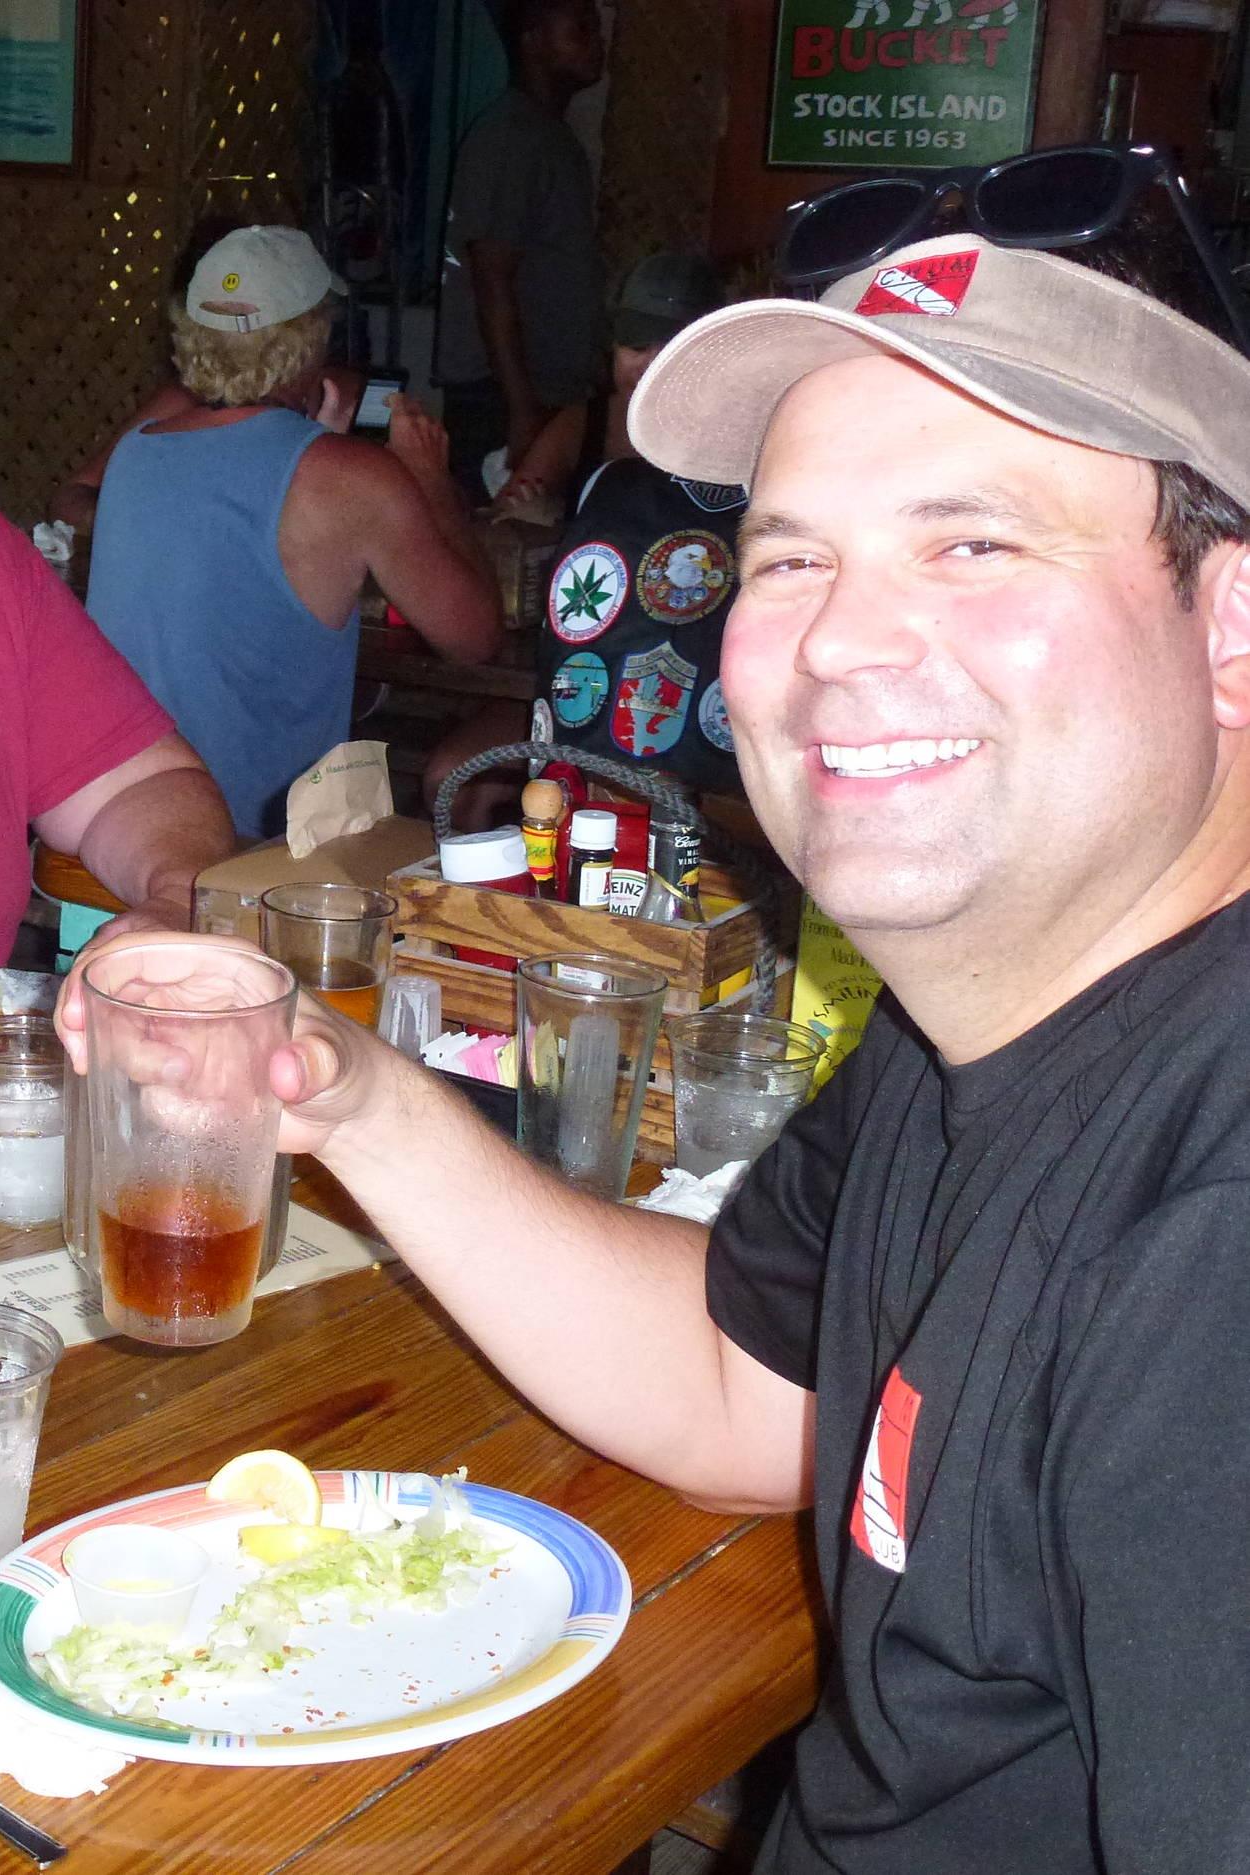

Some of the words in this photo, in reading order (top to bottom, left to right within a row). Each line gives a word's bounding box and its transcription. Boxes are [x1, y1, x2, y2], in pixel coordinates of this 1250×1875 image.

[791, 26, 1008, 80] BUCKET
[794, 94, 882, 118] STOCK
[890, 94, 1007, 120] ISLAND
[823, 128, 897, 147] SINCE
[904, 128, 967, 150] 1963
[612, 882, 643, 897] EINZ
